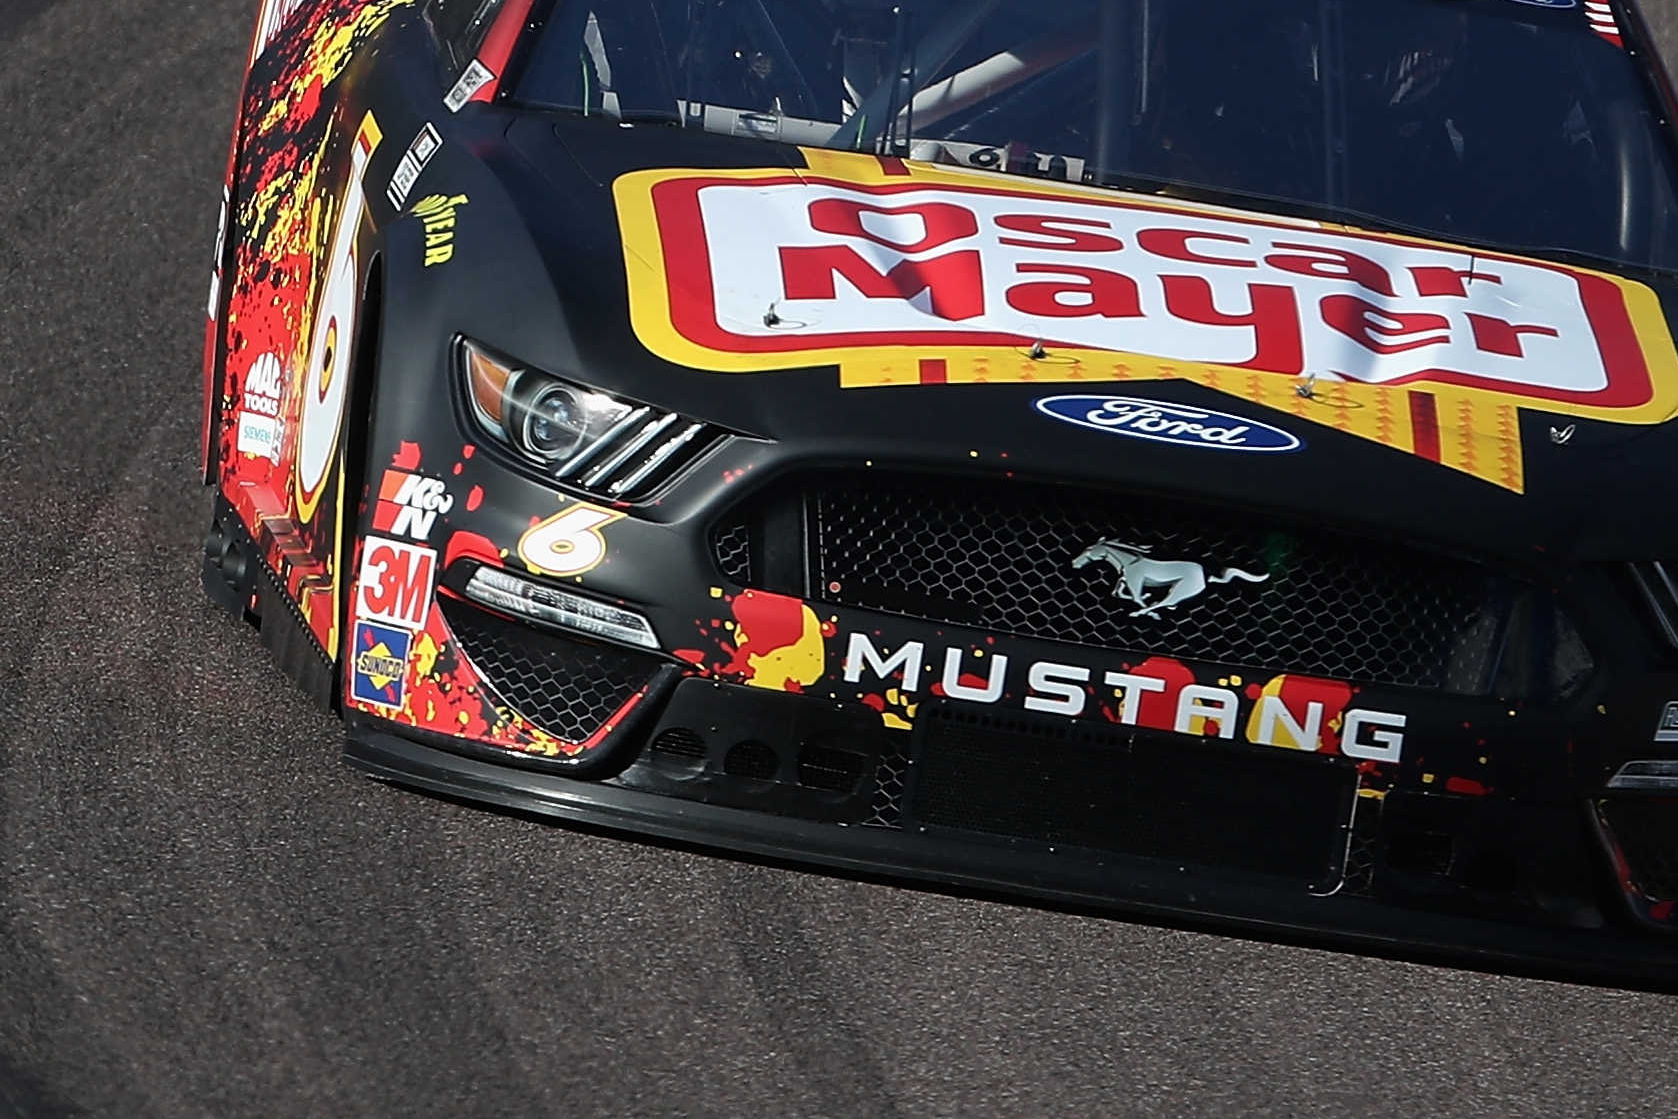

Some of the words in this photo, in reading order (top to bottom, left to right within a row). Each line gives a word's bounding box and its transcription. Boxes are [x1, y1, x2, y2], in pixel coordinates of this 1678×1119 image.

[808, 197, 1503, 298] Oscar
[779, 245, 1559, 375] Mayer
[244, 393, 278, 416] TOOLS
[1086, 400, 1250, 444] Ford
[517, 502, 628, 575] 6
[363, 545, 432, 624] 3M
[359, 653, 403, 680] SUNOCO
[843, 631, 1407, 764] MUSTANG
